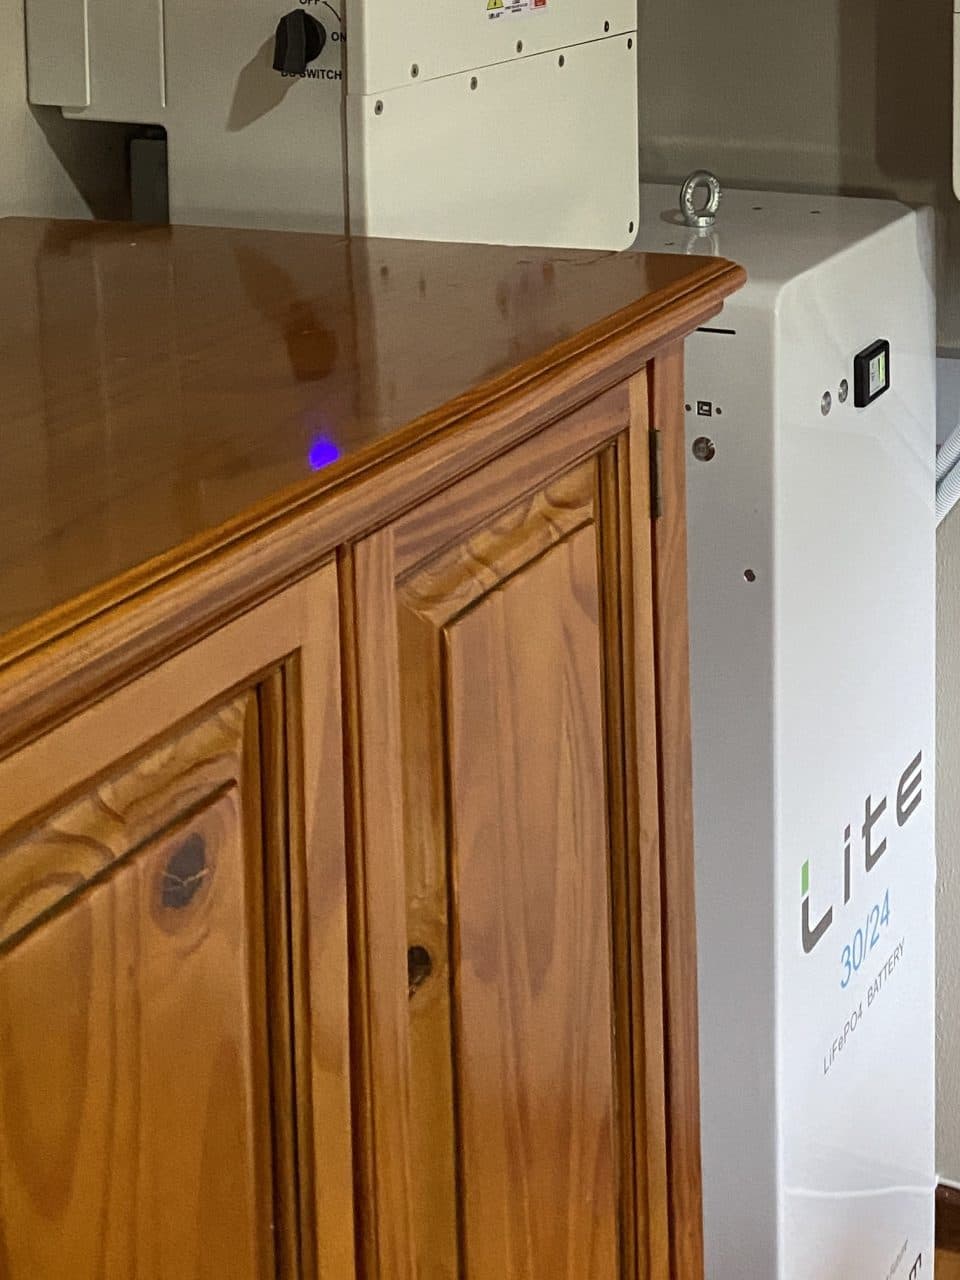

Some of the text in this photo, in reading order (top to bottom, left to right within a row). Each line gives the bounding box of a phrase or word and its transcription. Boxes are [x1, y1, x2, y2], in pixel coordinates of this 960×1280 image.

[840, 887, 890, 989] 30/24
[823, 936, 905, 1075] LiFePO4 BATTERY
